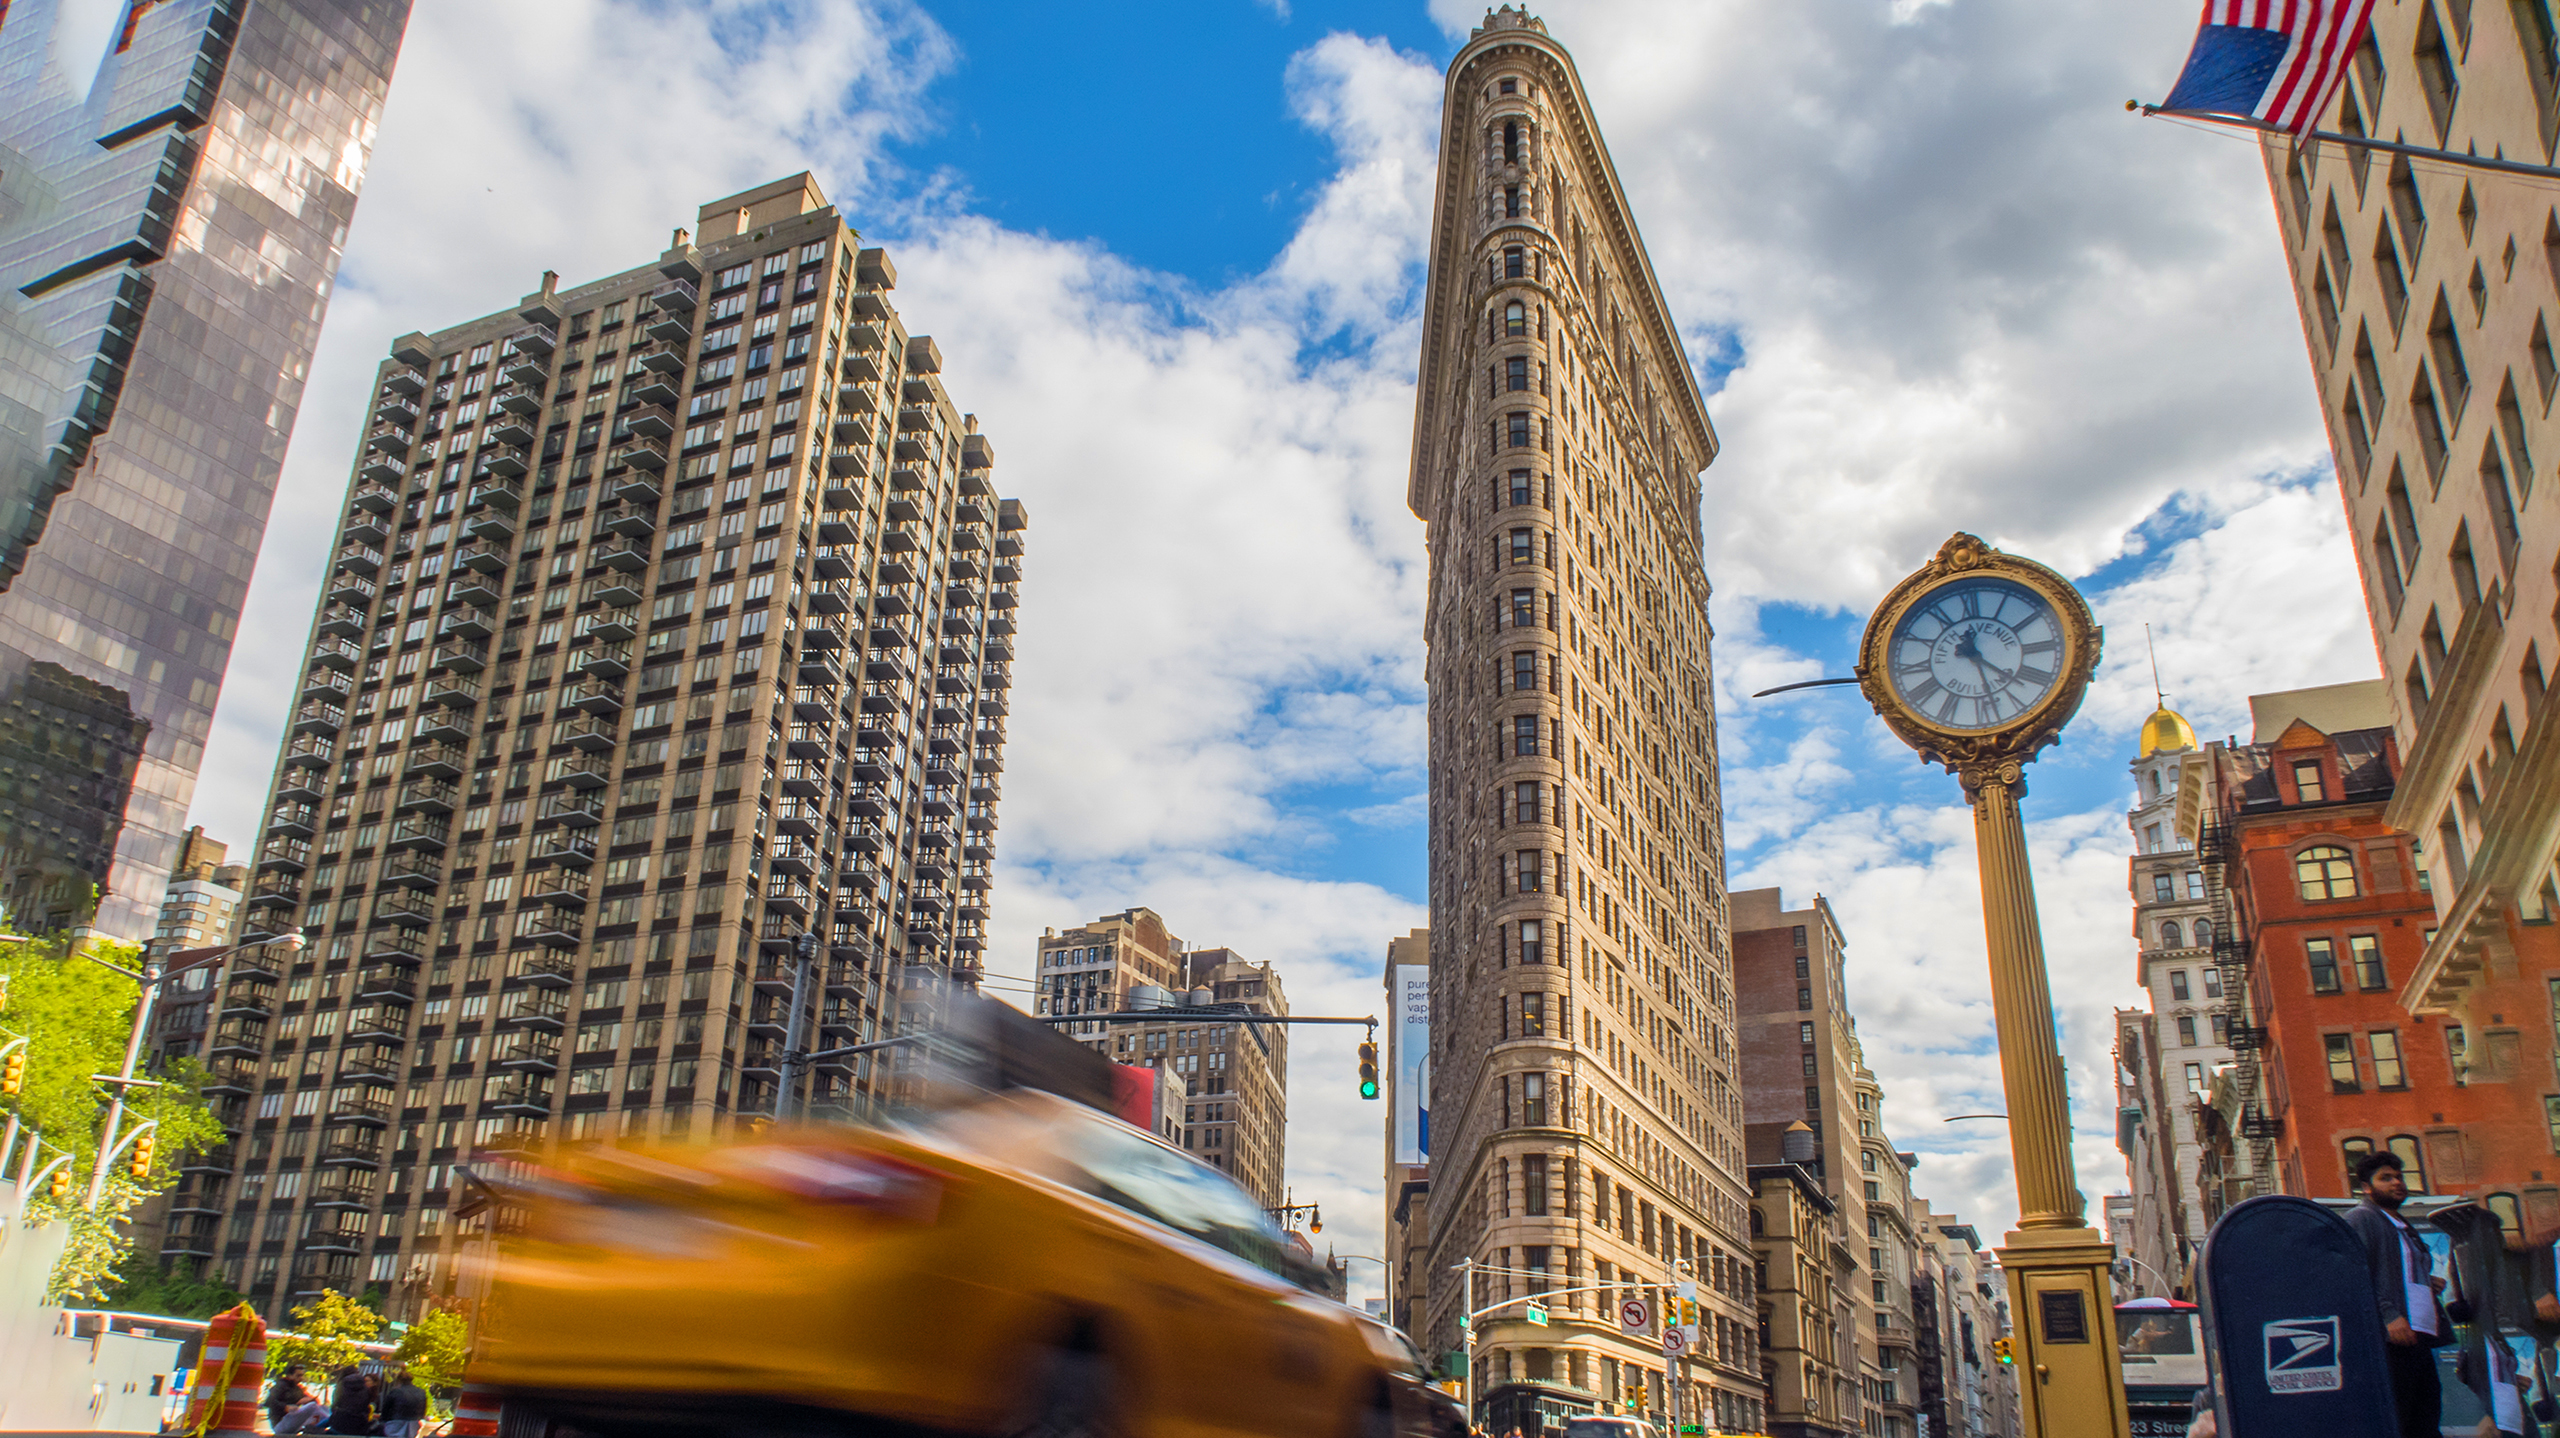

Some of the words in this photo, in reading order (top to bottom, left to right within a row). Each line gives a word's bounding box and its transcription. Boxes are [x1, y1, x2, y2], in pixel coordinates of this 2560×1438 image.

[1935, 630, 1960, 664] FIFTH
[1968, 622, 2017, 651] AVENUE
[1947, 671, 2010, 695] BUILIN
[1407, 1004, 1430, 1014] vap
[1407, 1014, 1429, 1024] dist
[2130, 1421, 2148, 1433] 23
[2152, 1421, 2189, 1433] Stree
